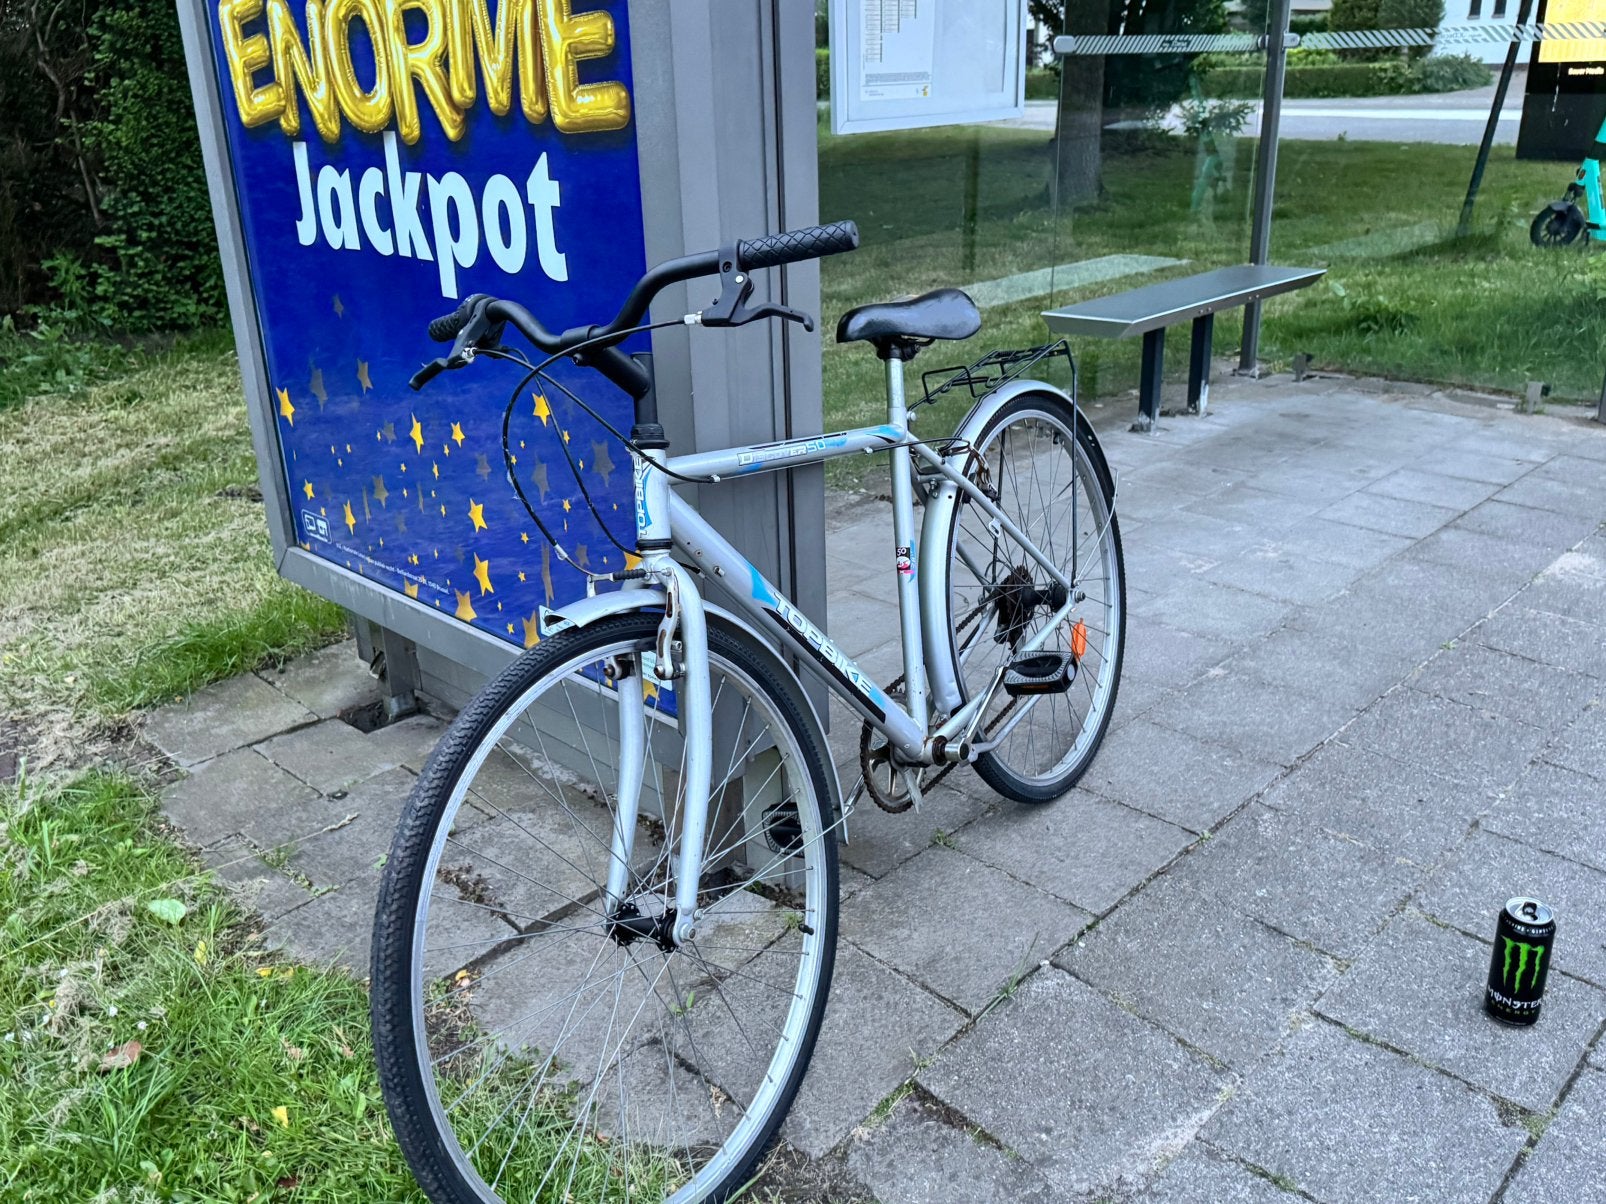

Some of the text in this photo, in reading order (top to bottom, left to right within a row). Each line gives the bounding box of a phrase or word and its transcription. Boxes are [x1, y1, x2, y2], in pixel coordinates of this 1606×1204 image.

[219, 0, 631, 145] ENORME
[292, 131, 568, 299] Jackpot
[633, 455, 648, 538] TOPBIKE
[774, 592, 872, 697] TOPBIKE
[1487, 984, 1542, 1009] MONSTER
